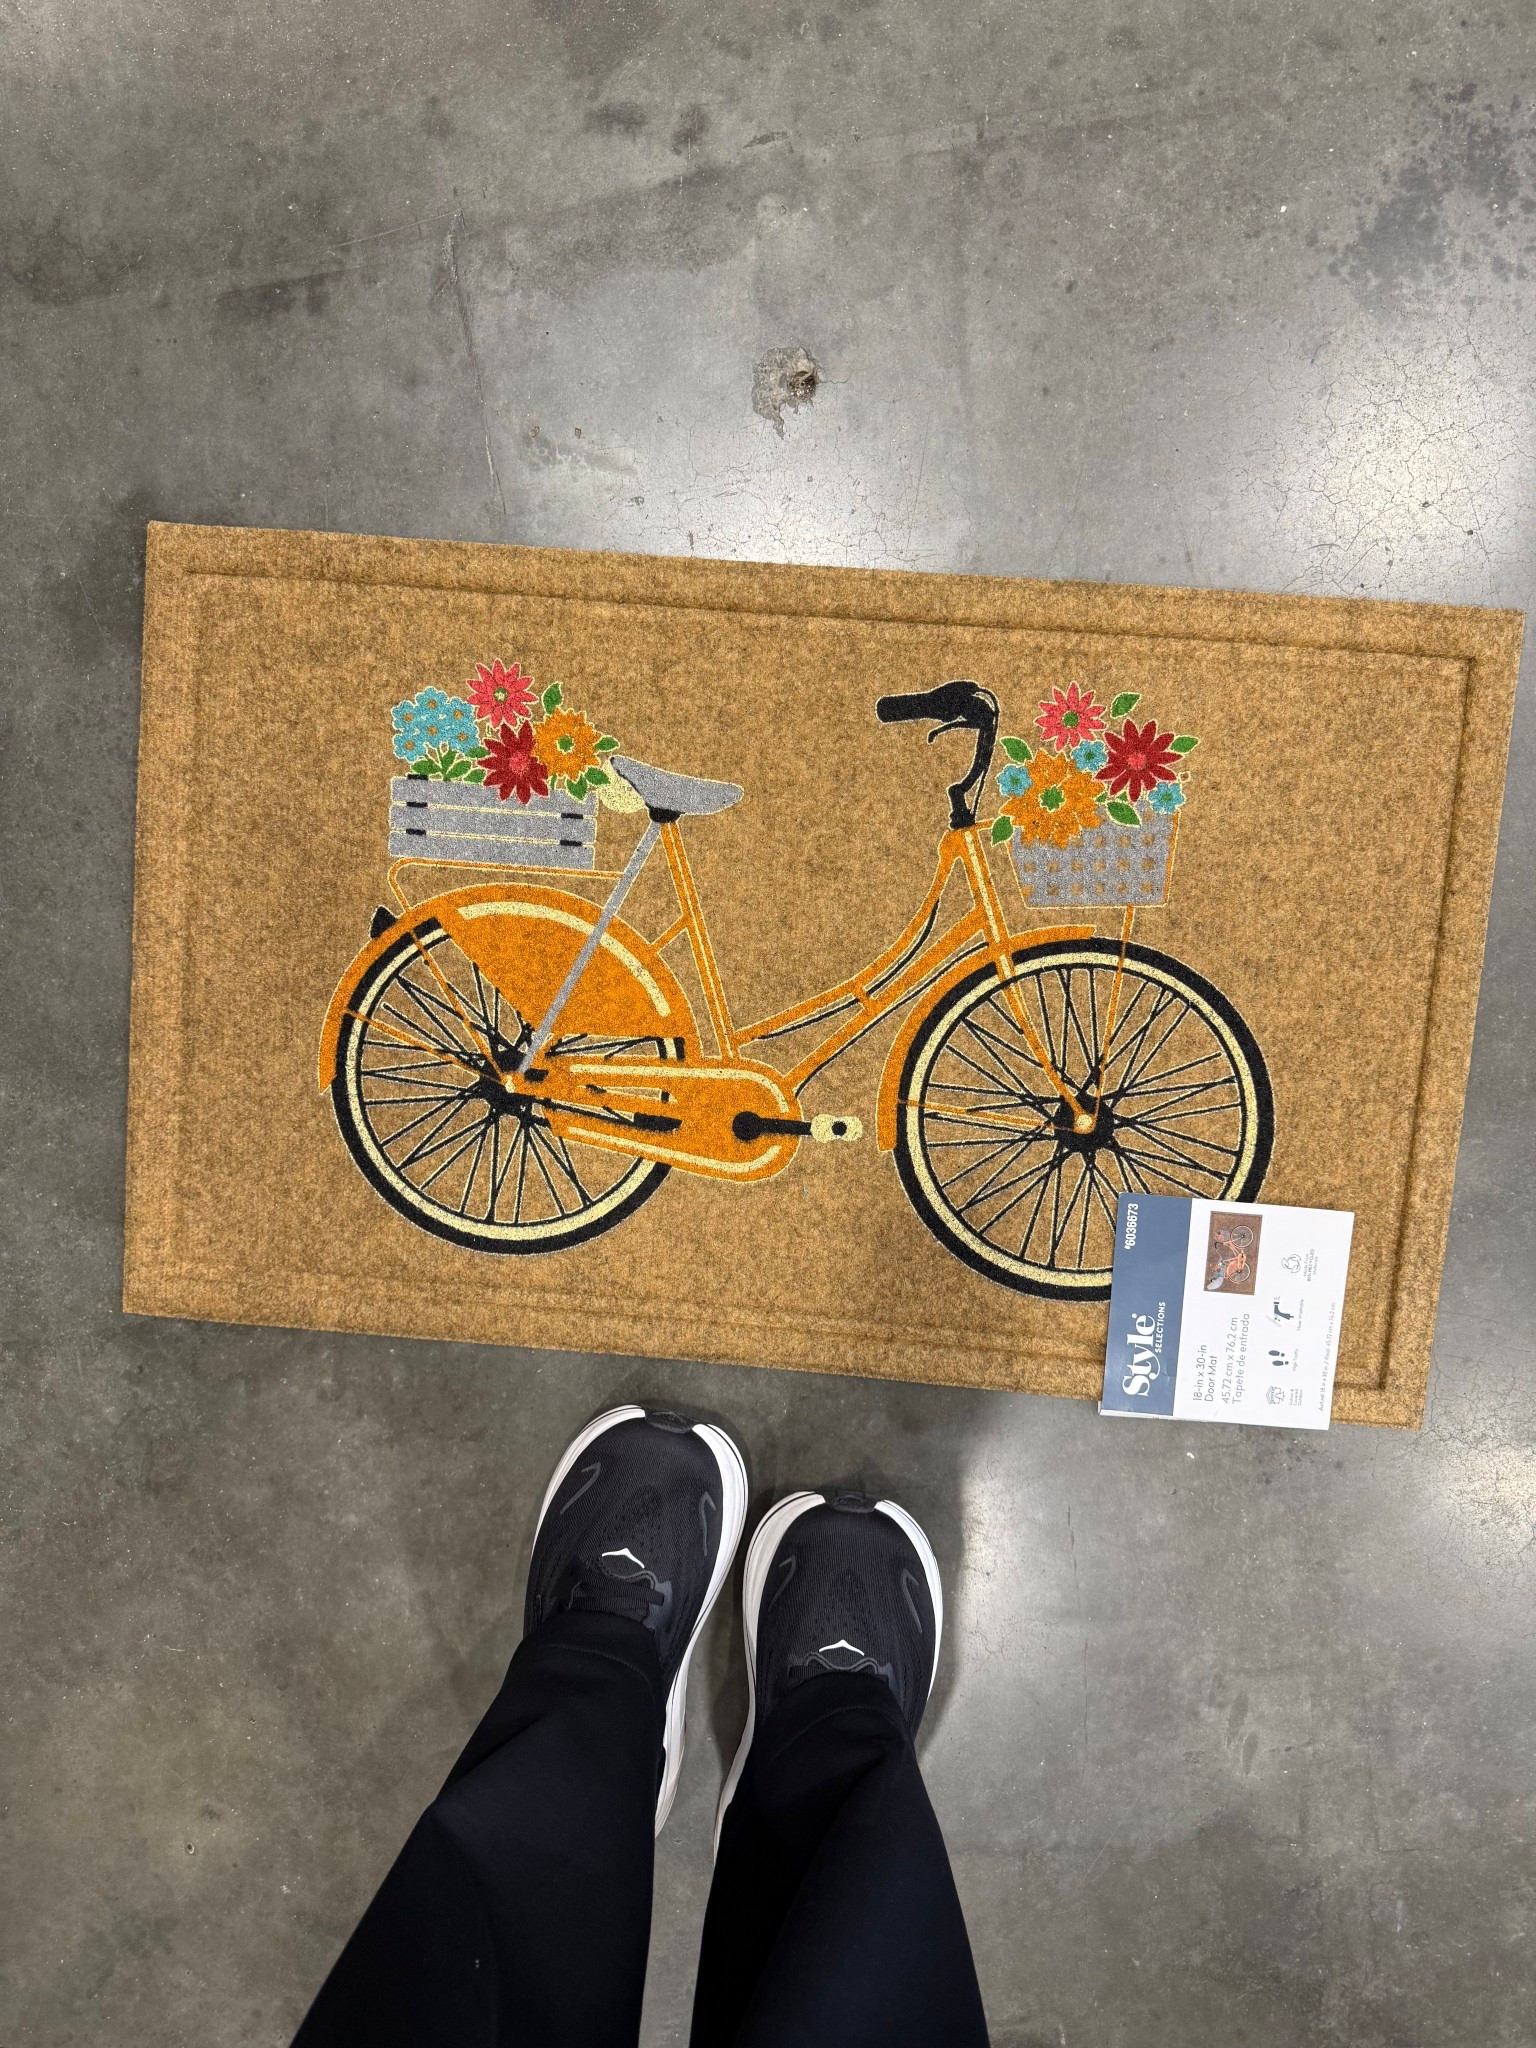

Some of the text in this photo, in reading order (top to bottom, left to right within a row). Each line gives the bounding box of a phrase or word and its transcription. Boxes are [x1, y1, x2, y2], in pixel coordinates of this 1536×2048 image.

[1154, 1301, 1166, 1353] SELECTIONS
[1230, 1317, 1238, 1331] cm
[1122, 1314, 1161, 1397] Style
[1226, 1333, 1237, 1353] 76.2
[1196, 1344, 1207, 1370] 30-in
[1226, 1362, 1234, 1376] cm
[1232, 1313, 1250, 1404] Tapete de entrada
[1193, 1379, 1204, 1401] 18-in
[1204, 1355, 1218, 1402] Door Mat
[1221, 1378, 1232, 1404] 45.72
